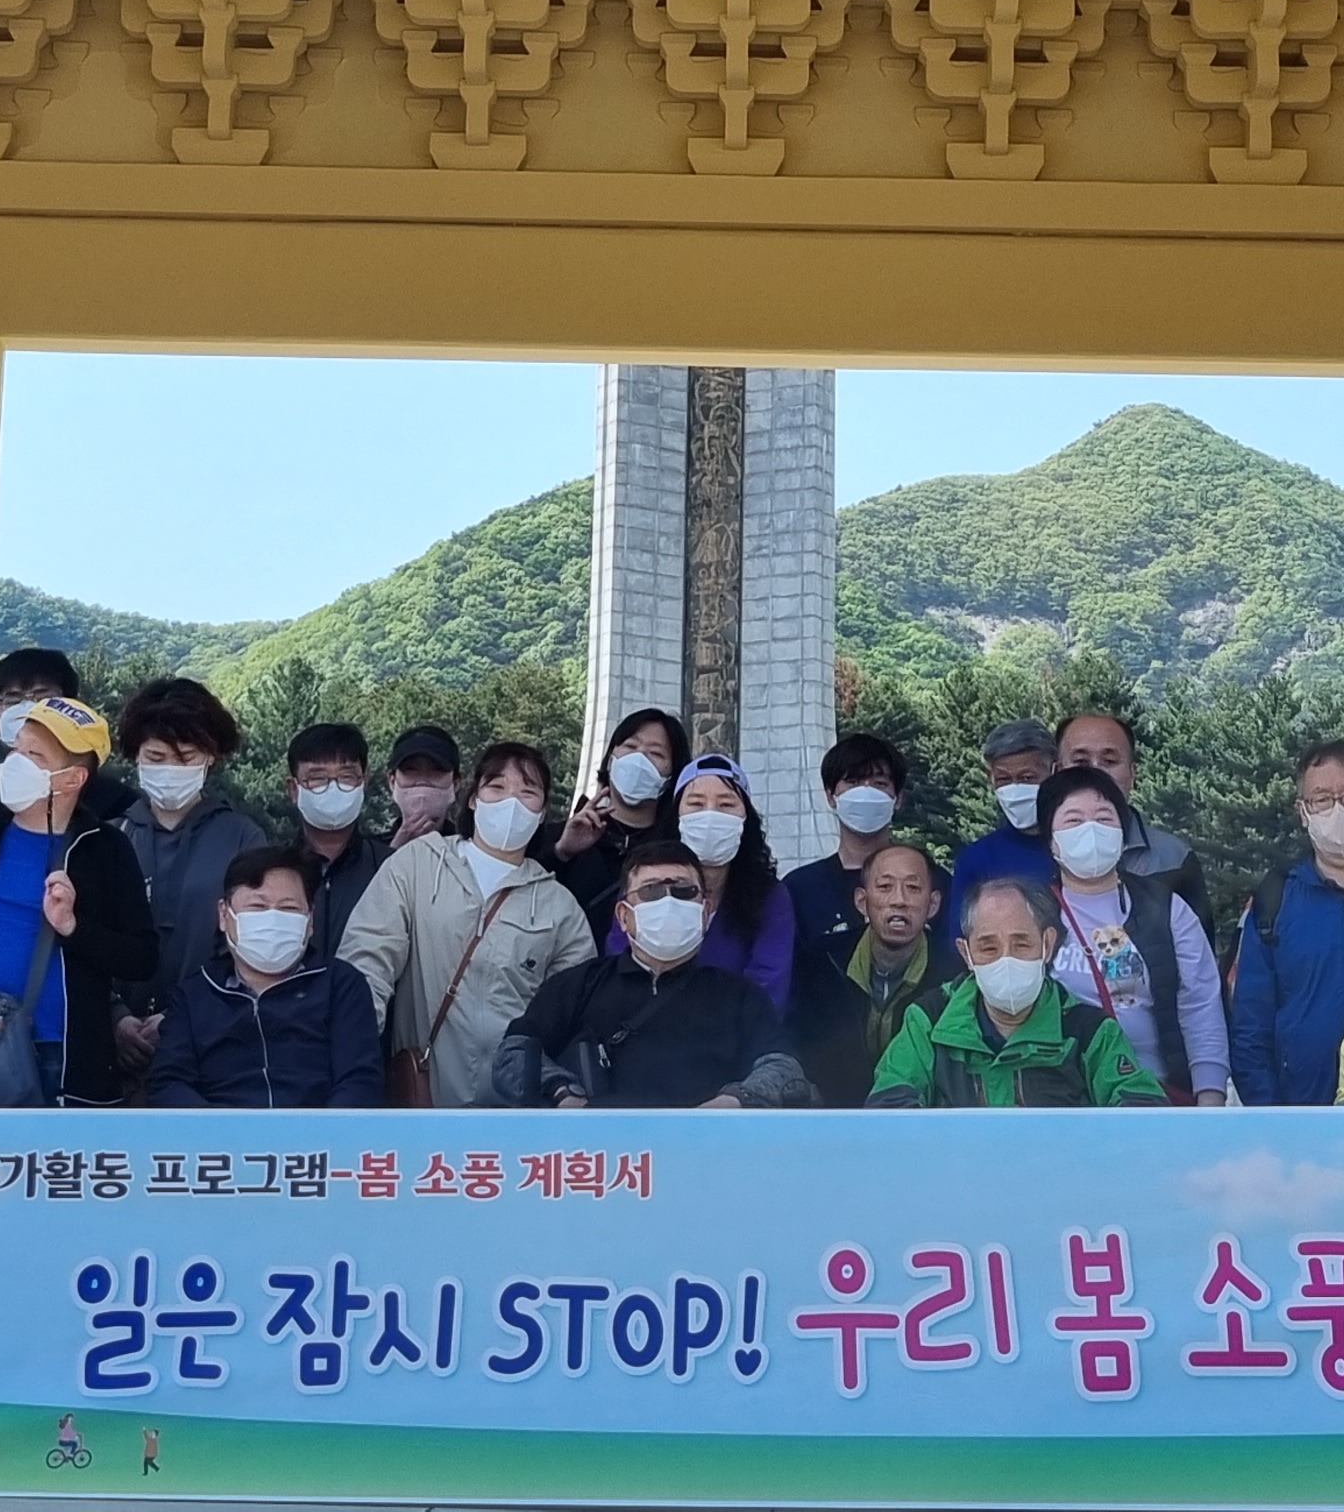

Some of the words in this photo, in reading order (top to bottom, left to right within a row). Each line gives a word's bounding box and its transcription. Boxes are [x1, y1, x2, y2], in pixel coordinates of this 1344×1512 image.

[413, 1152, 504, 1198] 소풍
[518, 1152, 652, 1198] 계획서
[76, 1255, 238, 1390] 일은
[265, 1260, 456, 1387] 잠시
[488, 1275, 762, 1377] STOP!
[796, 1249, 1012, 1390] 우리
[1055, 1233, 1147, 1392] 봄
